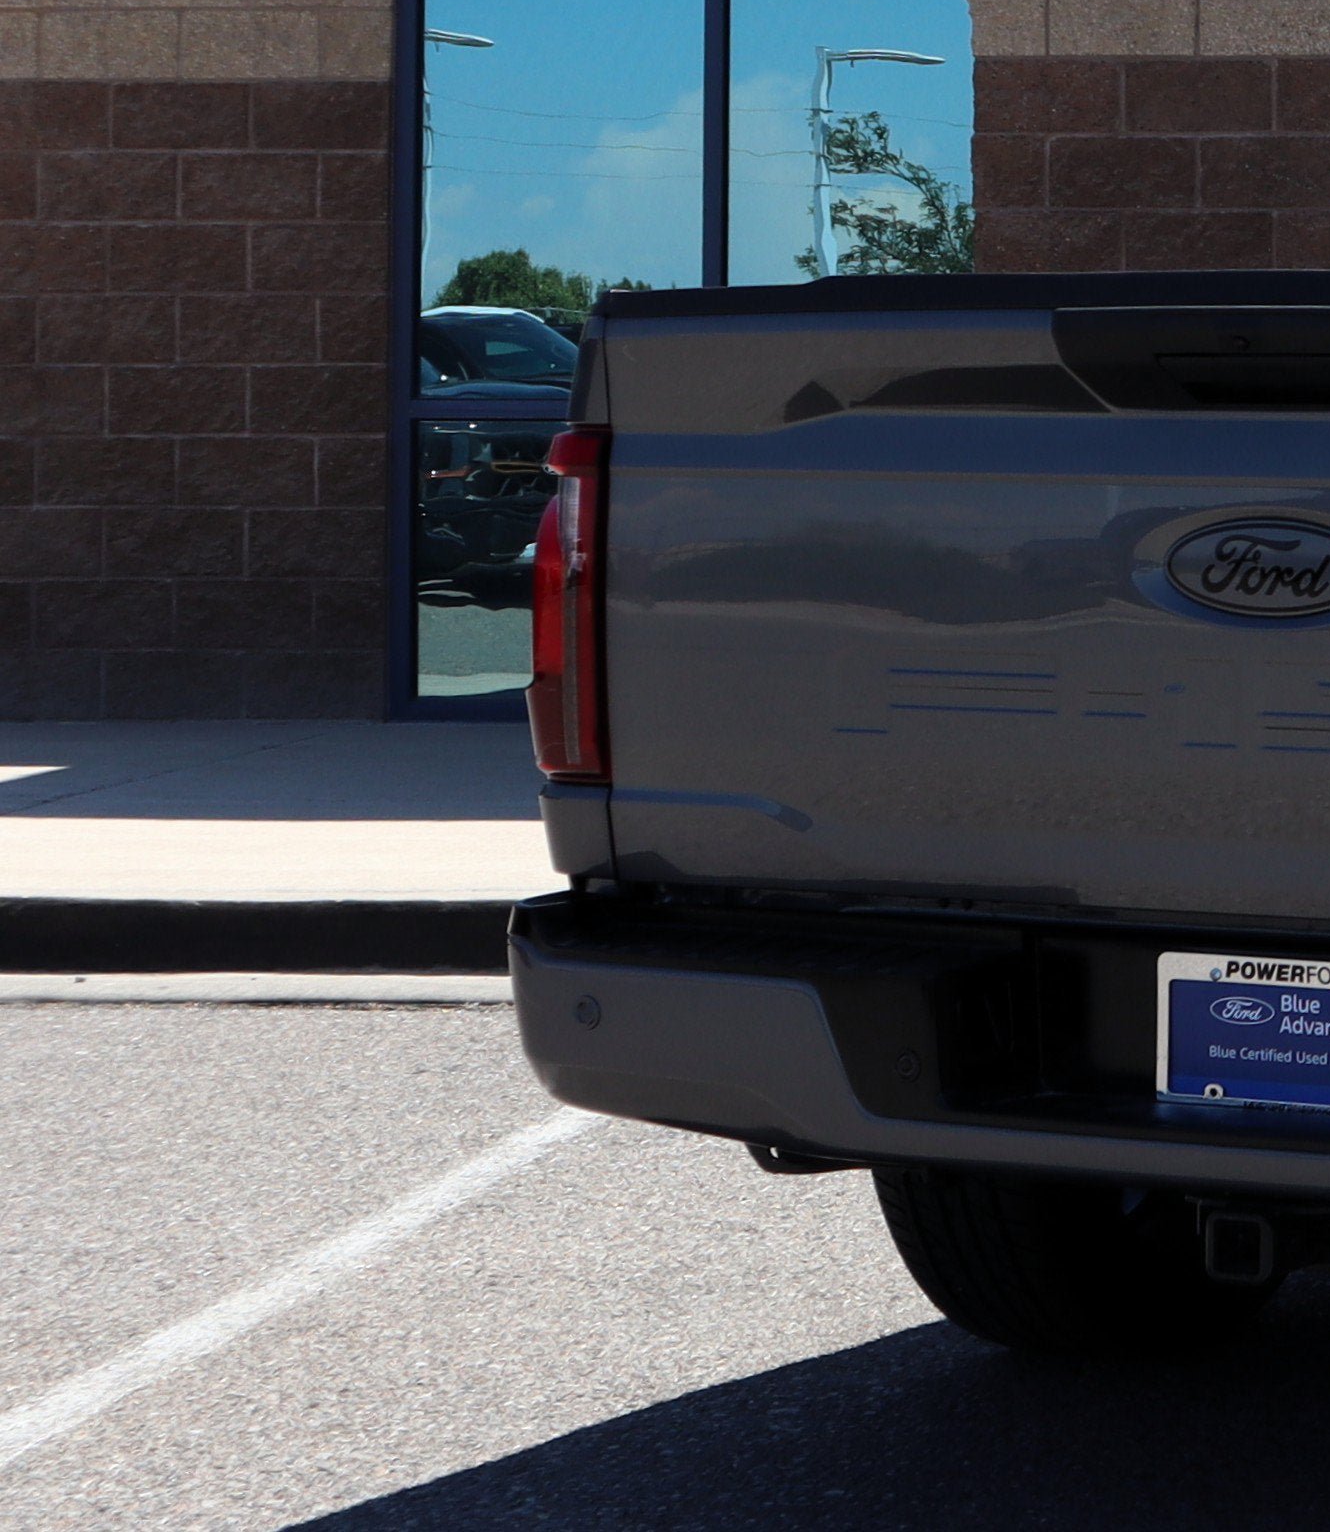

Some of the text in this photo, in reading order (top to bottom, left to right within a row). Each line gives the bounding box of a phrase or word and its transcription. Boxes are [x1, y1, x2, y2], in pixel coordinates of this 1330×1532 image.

[1221, 998, 1264, 1021] Ford
[1280, 994, 1321, 1015] Blue
[1209, 1044, 1236, 1059] Blue
[1240, 1047, 1292, 1064] Certified
[1296, 1050, 1328, 1066] Used
